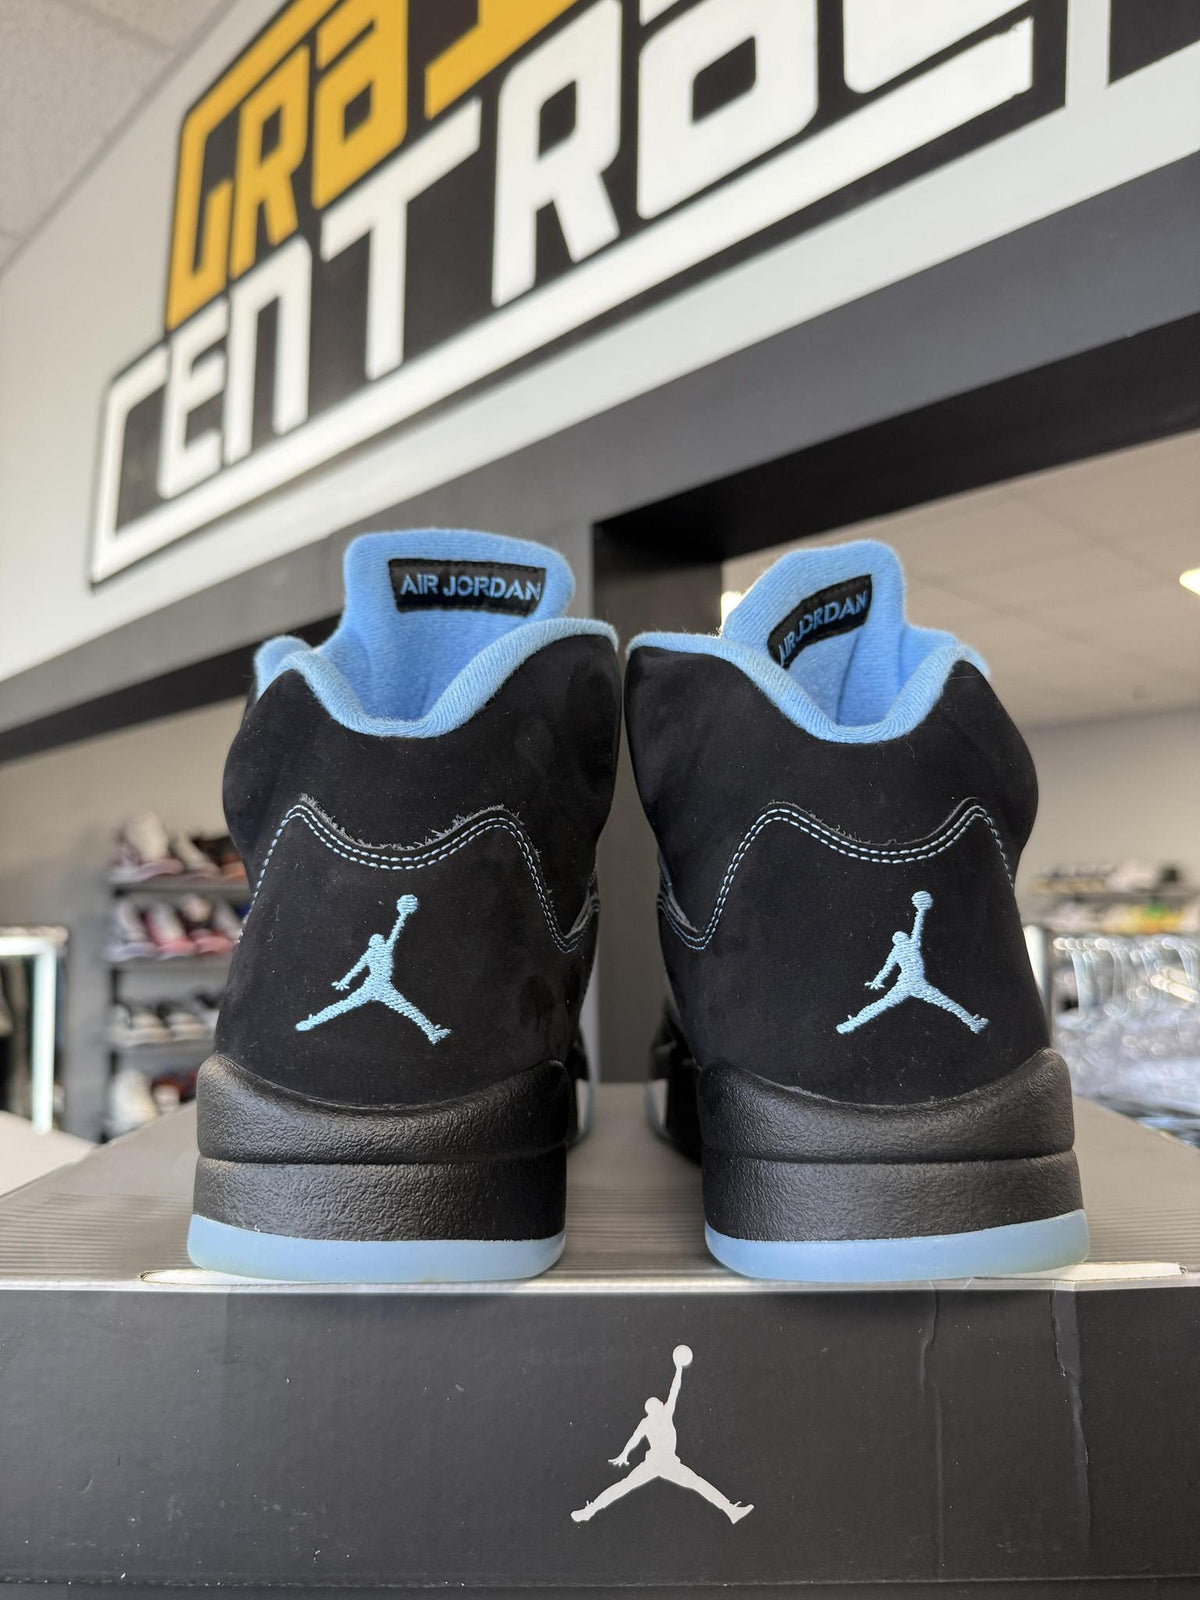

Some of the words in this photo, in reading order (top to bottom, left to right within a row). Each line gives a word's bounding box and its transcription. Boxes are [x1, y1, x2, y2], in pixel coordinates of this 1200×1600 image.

[400, 573, 439, 596] AIR
[442, 575, 542, 601] JORDAN
[795, 589, 867, 643] JORDAN
